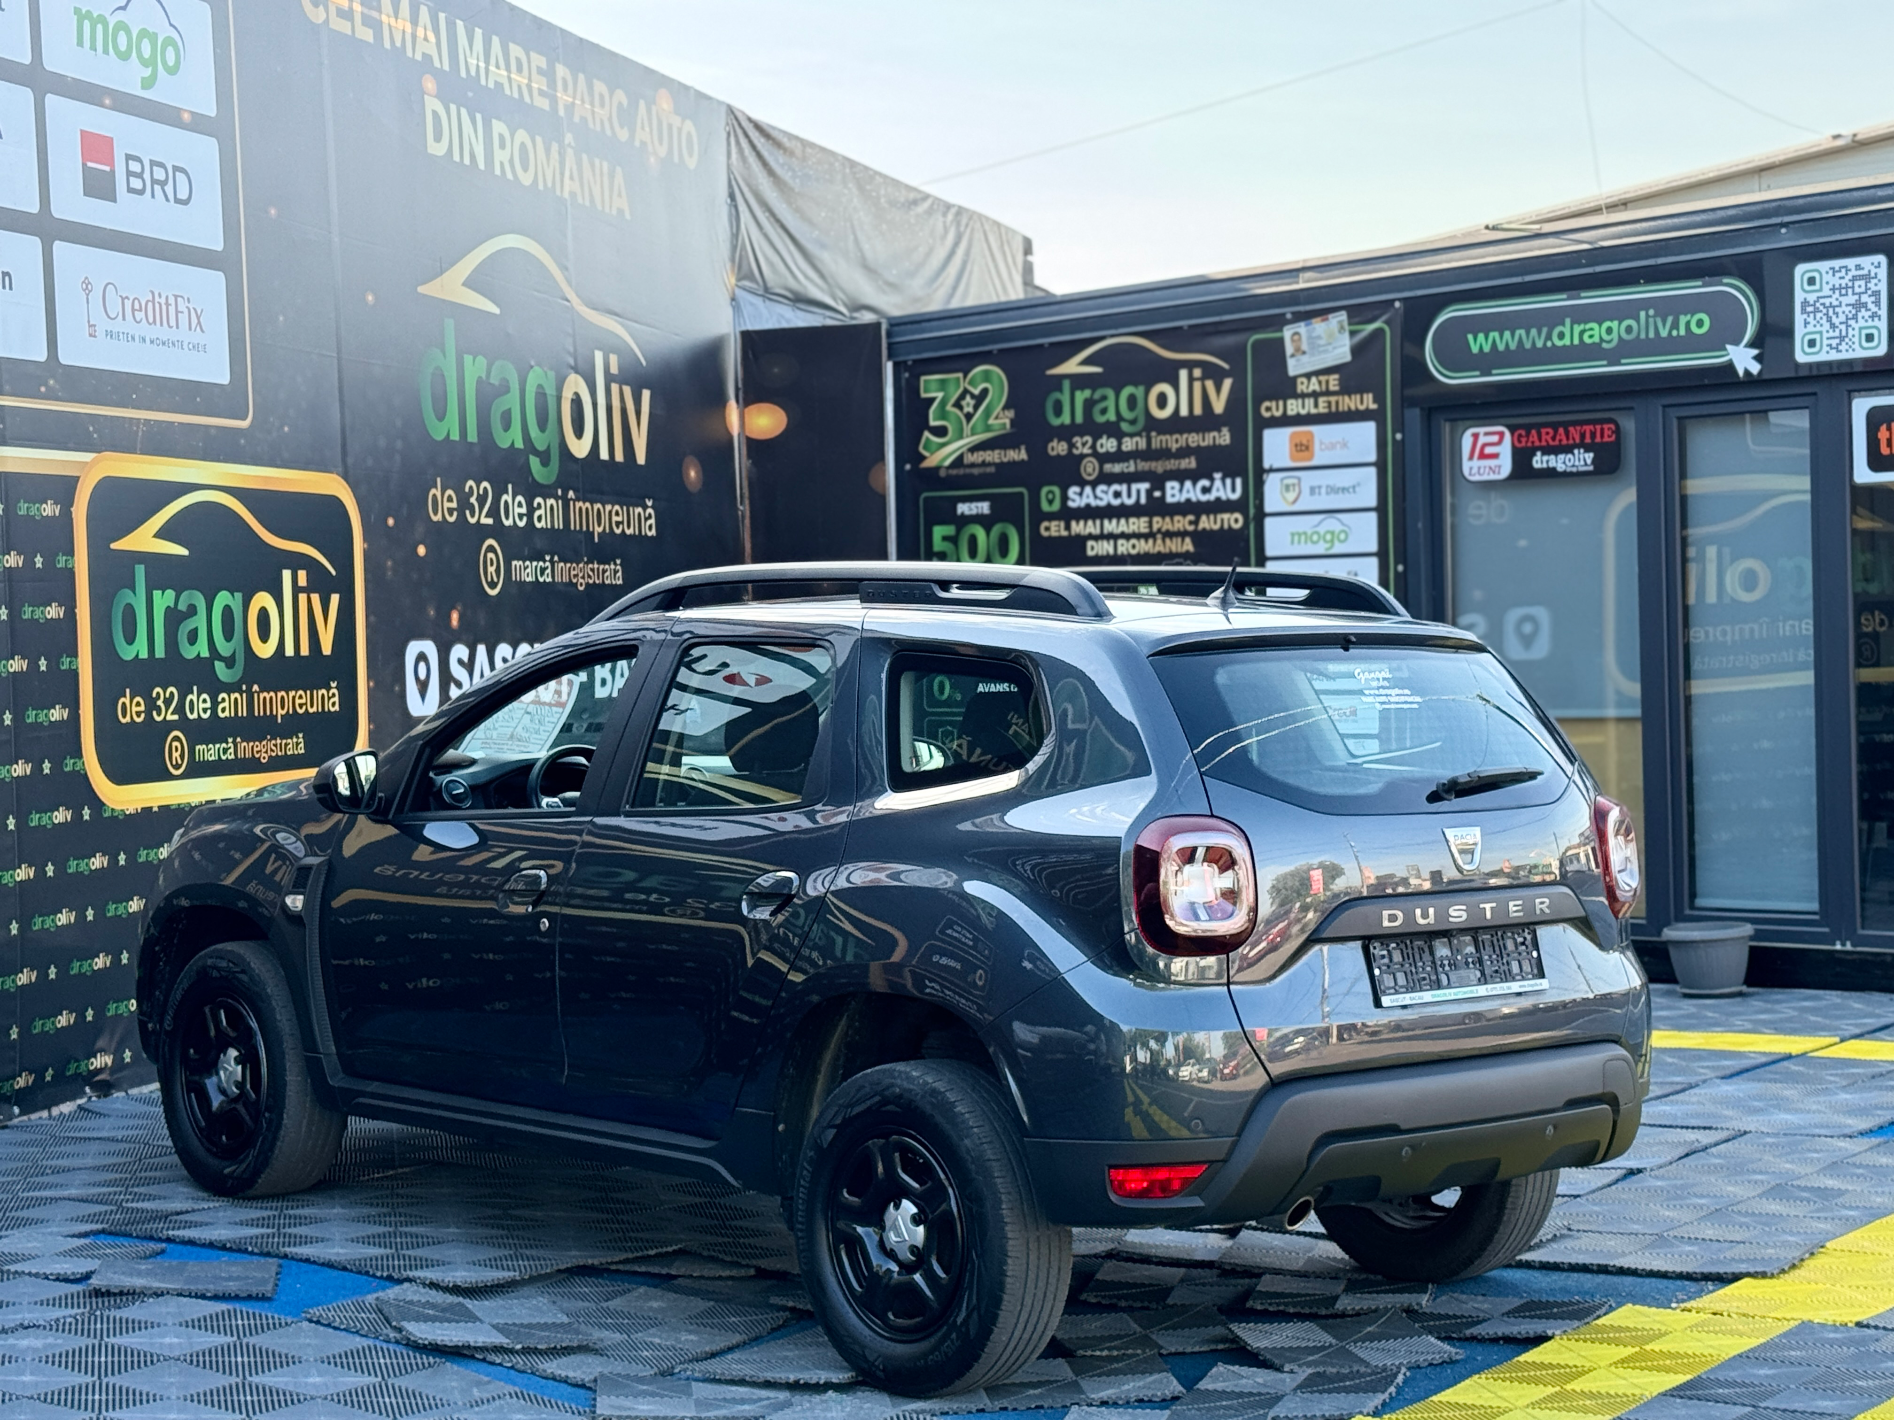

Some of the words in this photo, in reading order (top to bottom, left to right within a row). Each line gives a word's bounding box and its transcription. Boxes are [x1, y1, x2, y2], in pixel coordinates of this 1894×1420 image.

[73, 6, 182, 91] mogo
[302, 0, 374, 44] CEL
[381, 0, 449, 72] MAI
[455, 19, 550, 111] MARE
[555, 63, 629, 143] PARC
[634, 98, 698, 170] AUTO
[423, 94, 486, 171] DIN
[491, 118, 631, 220] ROMÂNIA
[124, 152, 193, 207] BRD
[101, 281, 206, 334] CreditFix
[104, 329, 136, 343] PRIETEN
[139, 334, 147, 345] IN
[149, 336, 185, 351] MOMENTE
[1466, 308, 1711, 355] www.dragoliv.ro
[1296, 374, 1340, 394] RATE
[419, 318, 651, 485] dragoliv
[918, 364, 1009, 458] 32
[1045, 367, 1234, 433] dragoliv
[1260, 400, 1284, 418] CU
[1286, 393, 1378, 416] BULETINUL
[1047, 438, 1068, 456] de
[1072, 435, 1093, 455] 32
[1096, 434, 1118, 453] de
[1121, 432, 1147, 451] ani
[1150, 427, 1231, 453] împreună
[1294, 439, 1310, 453] tbi
[1319, 438, 1350, 452] bank
[1467, 430, 1505, 462] 12
[1512, 423, 1616, 448] GARANTIE
[1102, 459, 1136, 474] marcă
[1468, 464, 1503, 477] LUNI
[1532, 448, 1594, 472] dragoliv
[1066, 481, 1150, 508] SASCUT
[1164, 472, 1243, 504] BACĂU
[1309, 486, 1323, 496] BT
[17, 499, 60, 520] dragoliv
[427, 476, 458, 523] de
[464, 479, 494, 525] 32
[499, 483, 528, 528] de
[533, 488, 564, 530] ani
[567, 489, 657, 543] împreună
[956, 501, 991, 516] PESTE
[1039, 520, 1069, 537] CEL
[1070, 518, 1101, 536] MAI
[1102, 517, 1150, 534] MARE
[1152, 515, 1196, 532] PARC
[1197, 512, 1244, 530] AUTO
[931, 521, 1020, 566] 500
[1086, 539, 1115, 556] DIN
[1116, 533, 1195, 556] ROMÂNIA
[1289, 529, 1349, 552] mogo
[511, 554, 553, 583] marcă
[553, 555, 624, 591] înregistrată
[21, 602, 65, 623] dragoliv
[111, 563, 341, 683] dragoliv
[976, 682, 1010, 694] AVANS
[25, 703, 69, 726] dragoliv
[116, 688, 146, 724] de
[152, 686, 180, 722] 32
[185, 685, 212, 720] de
[217, 684, 247, 718] ani
[252, 681, 340, 724] împreună
[195, 737, 236, 762] marcă
[236, 733, 305, 763] înregistrată
[28, 805, 73, 829] dragoliv
[66, 852, 109, 875] dragoliv
[31, 907, 77, 931] dragoliv
[105, 896, 147, 918] dragoliv
[1381, 897, 1552, 928] DUSTER
[69, 951, 112, 977] dragoliv
[31, 1010, 77, 1034] dragoliv
[65, 1052, 114, 1077] dragoliv
